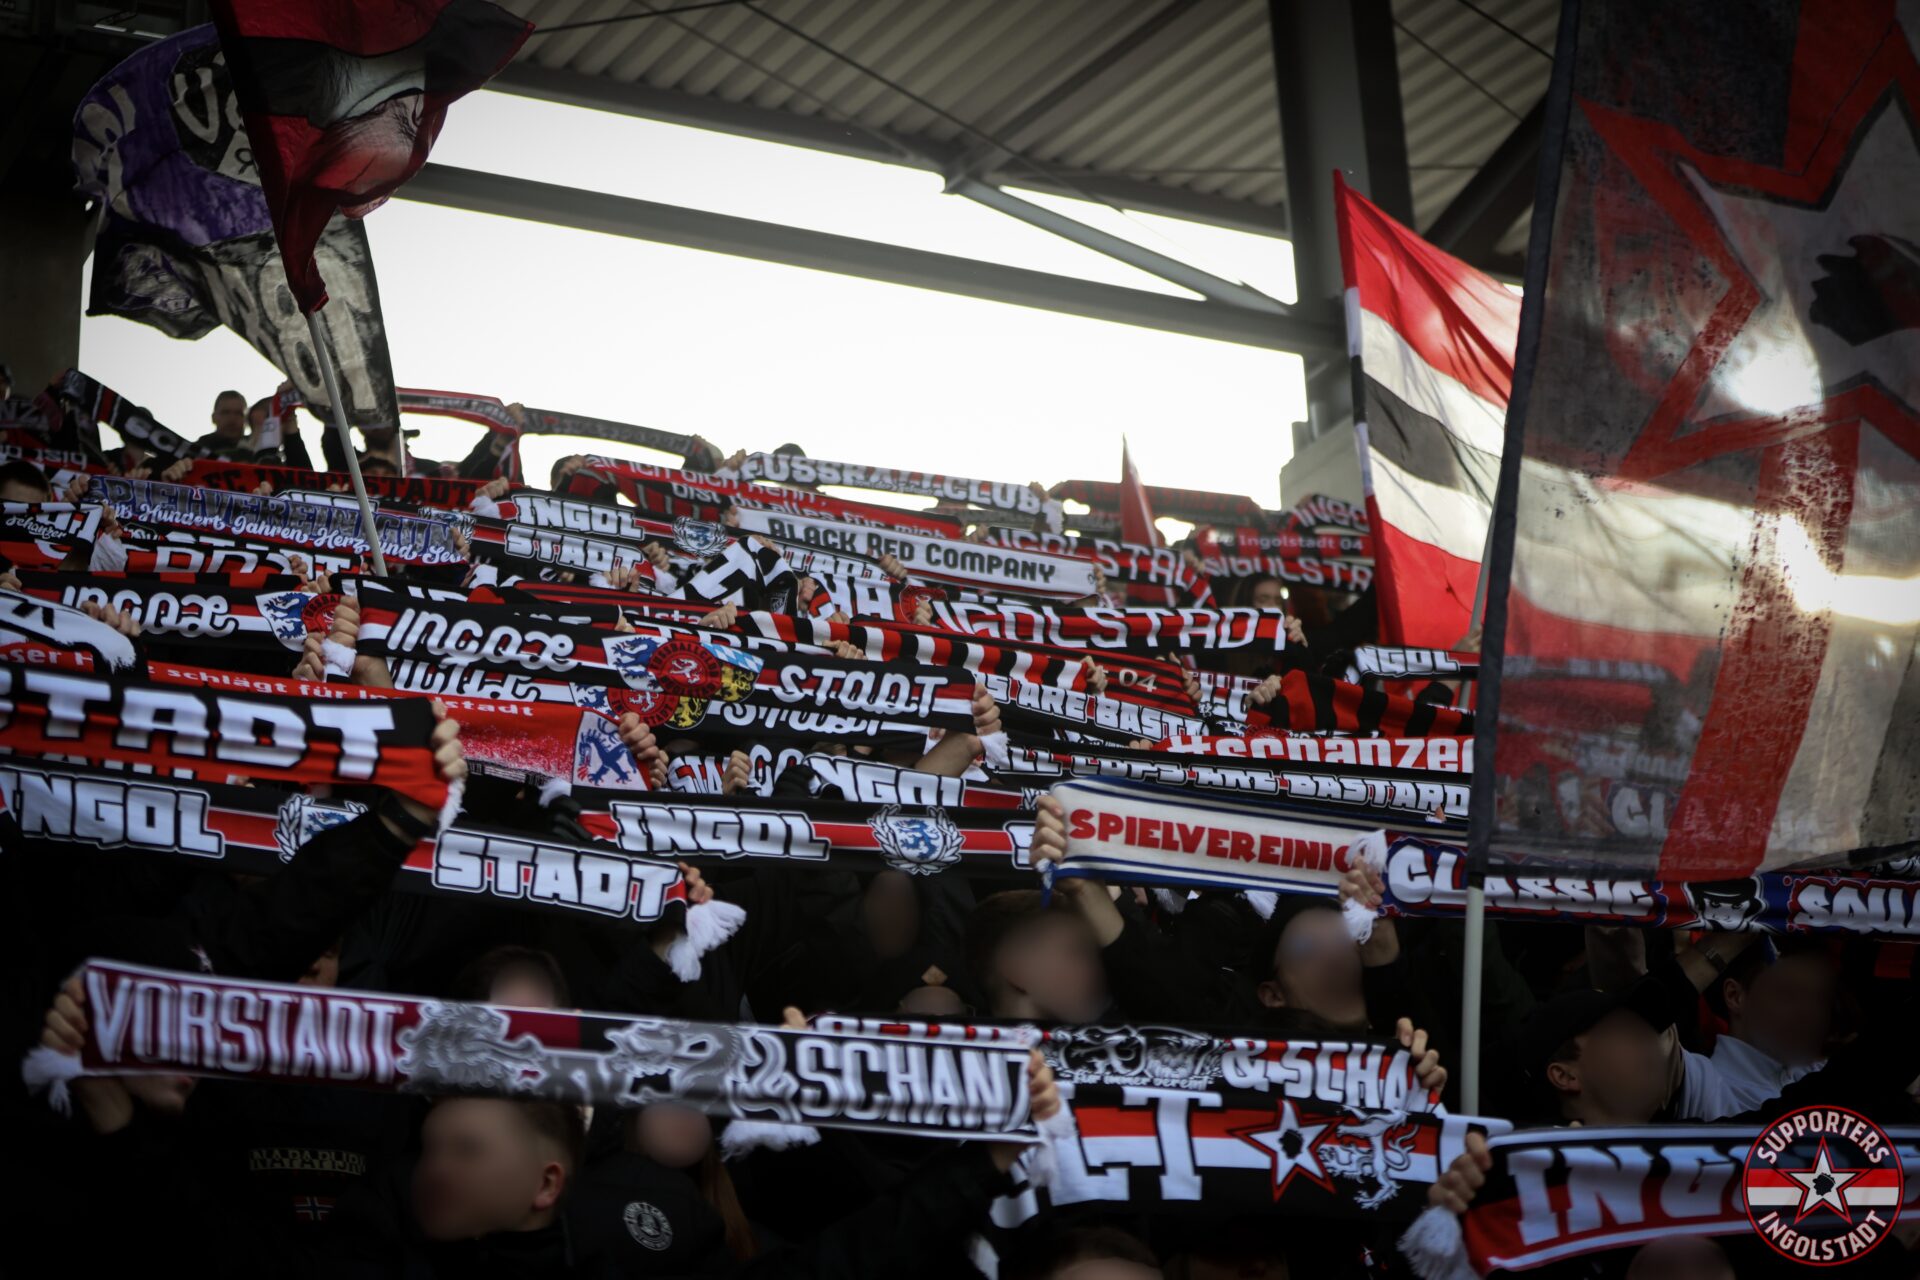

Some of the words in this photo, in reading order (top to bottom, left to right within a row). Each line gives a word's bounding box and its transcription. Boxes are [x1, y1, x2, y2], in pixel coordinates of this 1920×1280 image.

[511, 493, 644, 540] INGOL
[1241, 535, 1335, 551] Ingolstadt
[505, 524, 643, 575] STADT
[768, 518, 857, 552] BLACK
[866, 532, 914, 562] RED
[926, 543, 1056, 586] COMPANY
[0, 647, 60, 665] ser
[167, 667, 287, 694] schlägt
[298, 677, 348, 699] für
[1354, 645, 1460, 677] NGOL
[0, 668, 396, 780] TADT
[1017, 679, 1088, 724] ARE
[1095, 697, 1209, 742] BASTA
[1282, 773, 1473, 817] BASTARD
[611, 802, 830, 860] INGOL
[1069, 808, 1352, 874] SPIELVEREINIG
[433, 830, 681, 922] STADT
[85, 971, 403, 1085] VORSTADT
